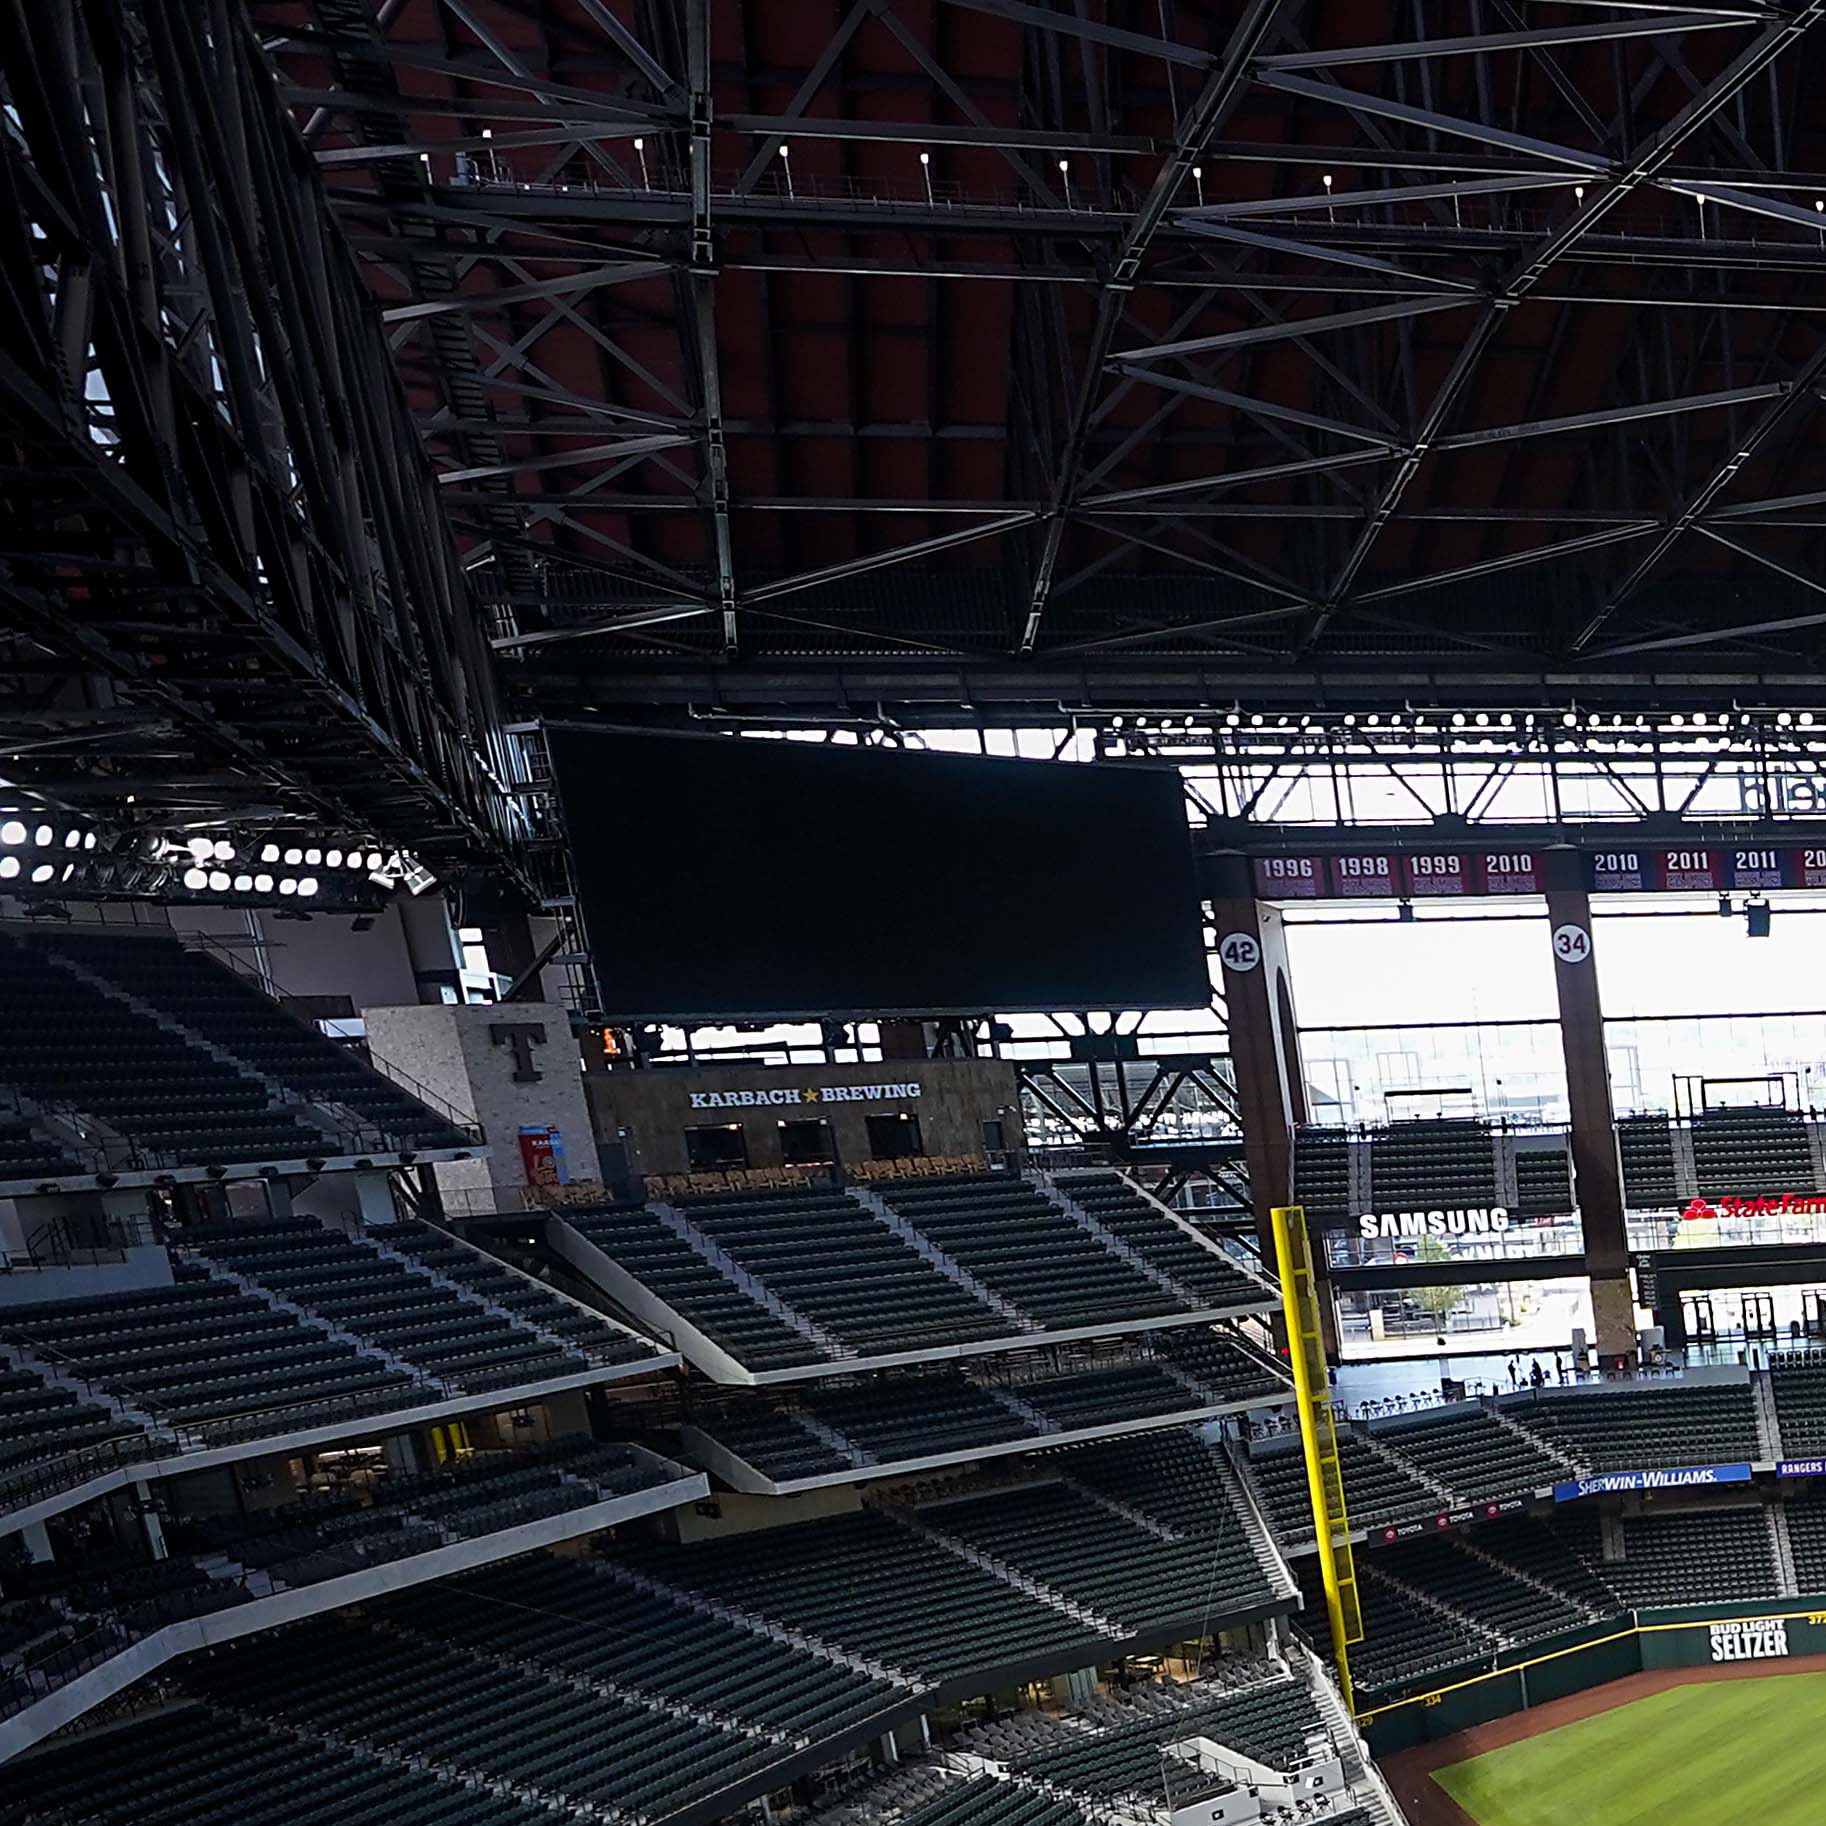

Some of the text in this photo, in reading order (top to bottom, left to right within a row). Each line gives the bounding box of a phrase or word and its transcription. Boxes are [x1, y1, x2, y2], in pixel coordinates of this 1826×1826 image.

[1263, 859, 1313, 878] 1996
[1339, 857, 1390, 876] 1998
[1410, 856, 1461, 875] 1999
[1487, 854, 1532, 873] 2010
[1595, 854, 1639, 872] 2010
[1667, 852, 1709, 870] 2011
[1736, 851, 1777, 869] 2011
[1225, 941, 1255, 963] 42
[1558, 933, 1587, 954] 34
[489, 1022, 547, 1082] T
[689, 1082, 921, 1108] KARBACH BREWING
[1360, 1207, 1509, 1239] SAMSUNG
[1781, 1460, 1823, 1474] RANGERS
[1499, 1499, 1525, 1512] TOYOTA
[1449, 1511, 1475, 1524] TOYOTA
[1397, 1523, 1424, 1537] TOYOTA
[1711, 1619, 1785, 1637] BUD LIGHT
[1711, 1632, 1788, 1661] SELTZER
